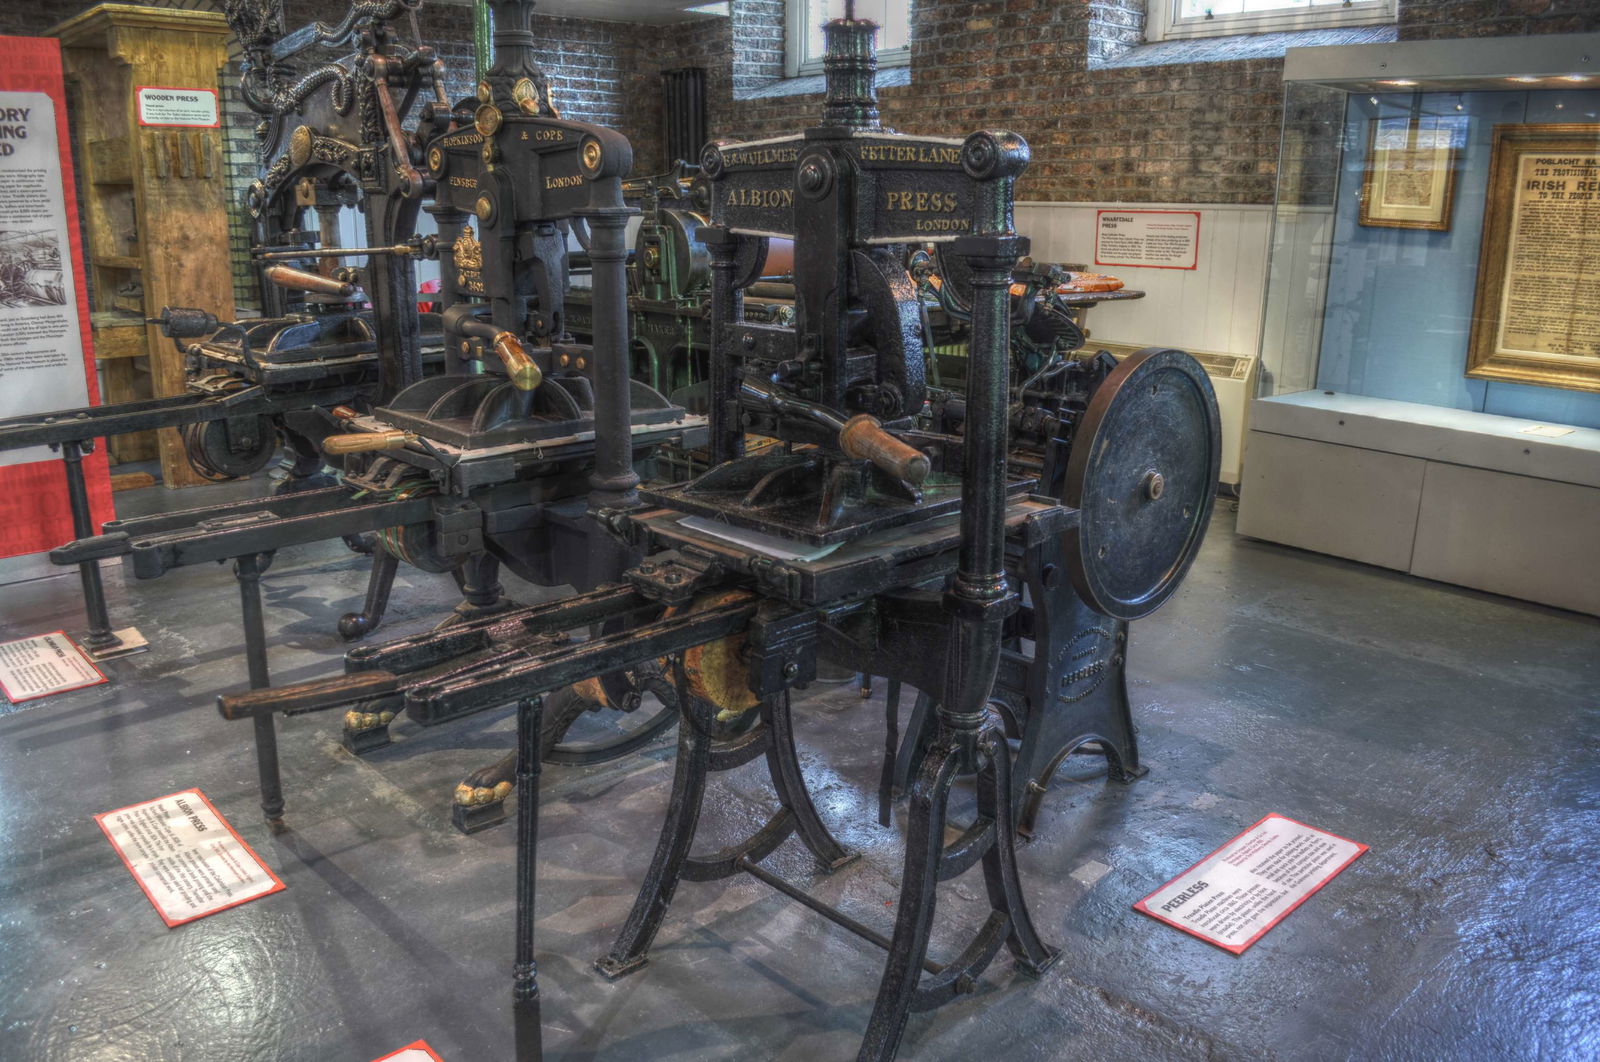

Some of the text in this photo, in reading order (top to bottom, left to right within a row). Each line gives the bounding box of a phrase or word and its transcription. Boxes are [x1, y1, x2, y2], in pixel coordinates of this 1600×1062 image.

[443, 134, 484, 148] HOPKINSON
[521, 130, 528, 140] &
[0, 143, 14, 157] D
[861, 145, 916, 161] FETTER
[918, 147, 960, 164] LANE
[545, 175, 583, 190] LONDON
[1526, 180, 1600, 191] IRISH RE
[727, 189, 958, 212] ALBION PRESS
[916, 220, 970, 232] LONDON
[176, 799, 207, 831] ALBION PRESS
[1161, 880, 1208, 912] PEERLESS
